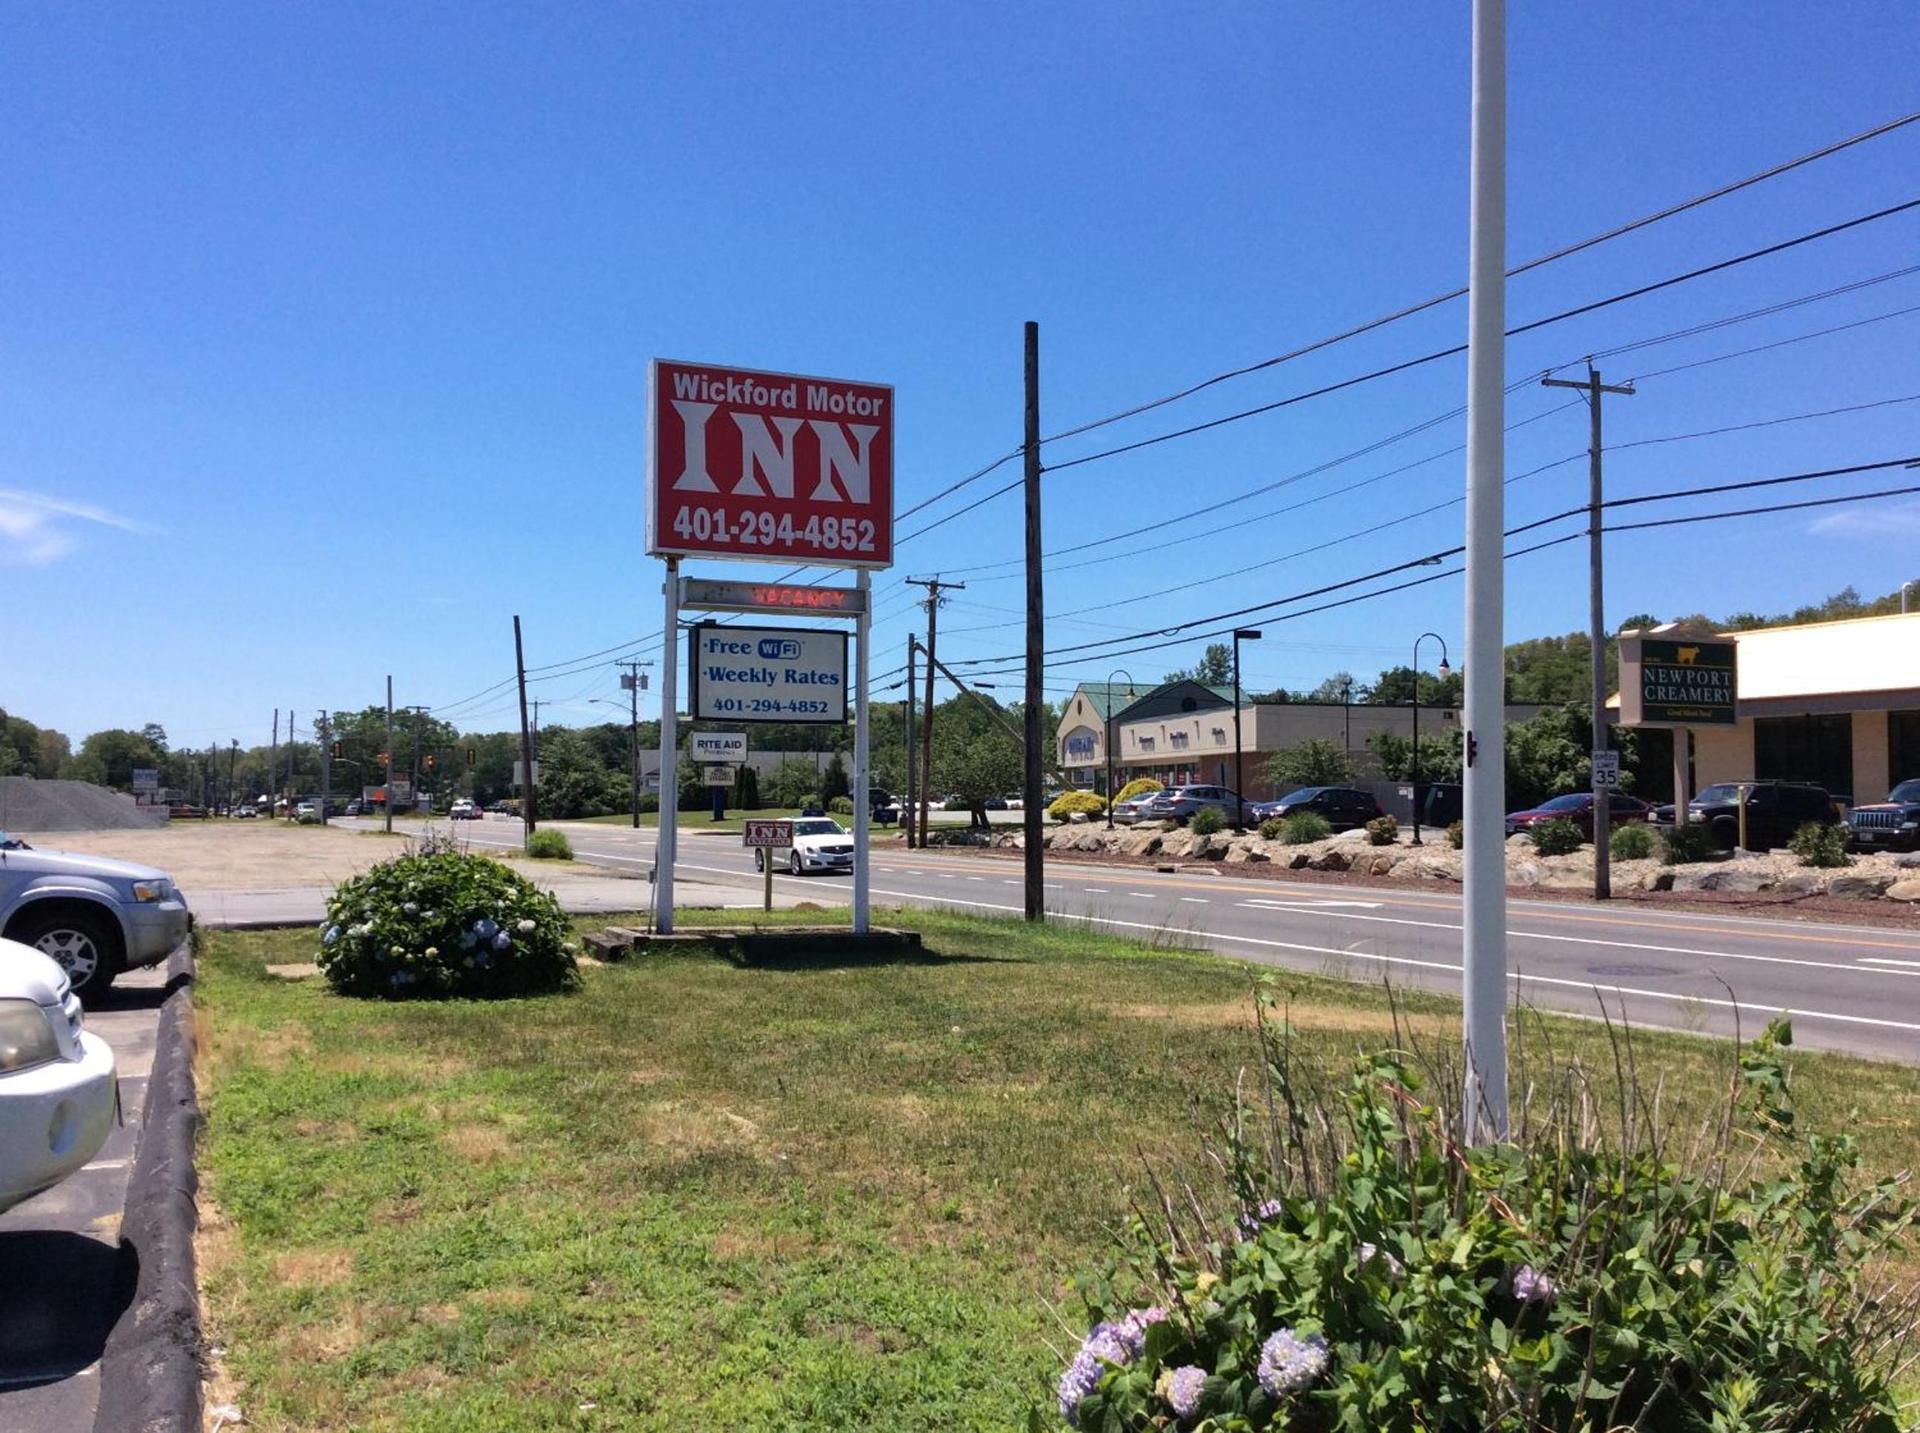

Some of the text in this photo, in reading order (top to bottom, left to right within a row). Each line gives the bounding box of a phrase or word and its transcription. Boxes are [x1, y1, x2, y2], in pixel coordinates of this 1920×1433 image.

[673, 373, 884, 416] Wickford Motor
[671, 399, 881, 504] INN
[673, 506, 875, 552] 401-294-4852
[754, 586, 845, 608] VACANCY
[708, 666, 839, 687] Weekly Rates
[1644, 668, 1731, 686] NEWPORT
[1644, 685, 1731, 702] CREAMERY
[714, 698, 828, 713] 401-294-4852
[697, 740, 742, 749] RITE AID
[1595, 770, 1616, 784] 35
[749, 826, 789, 838] INN
